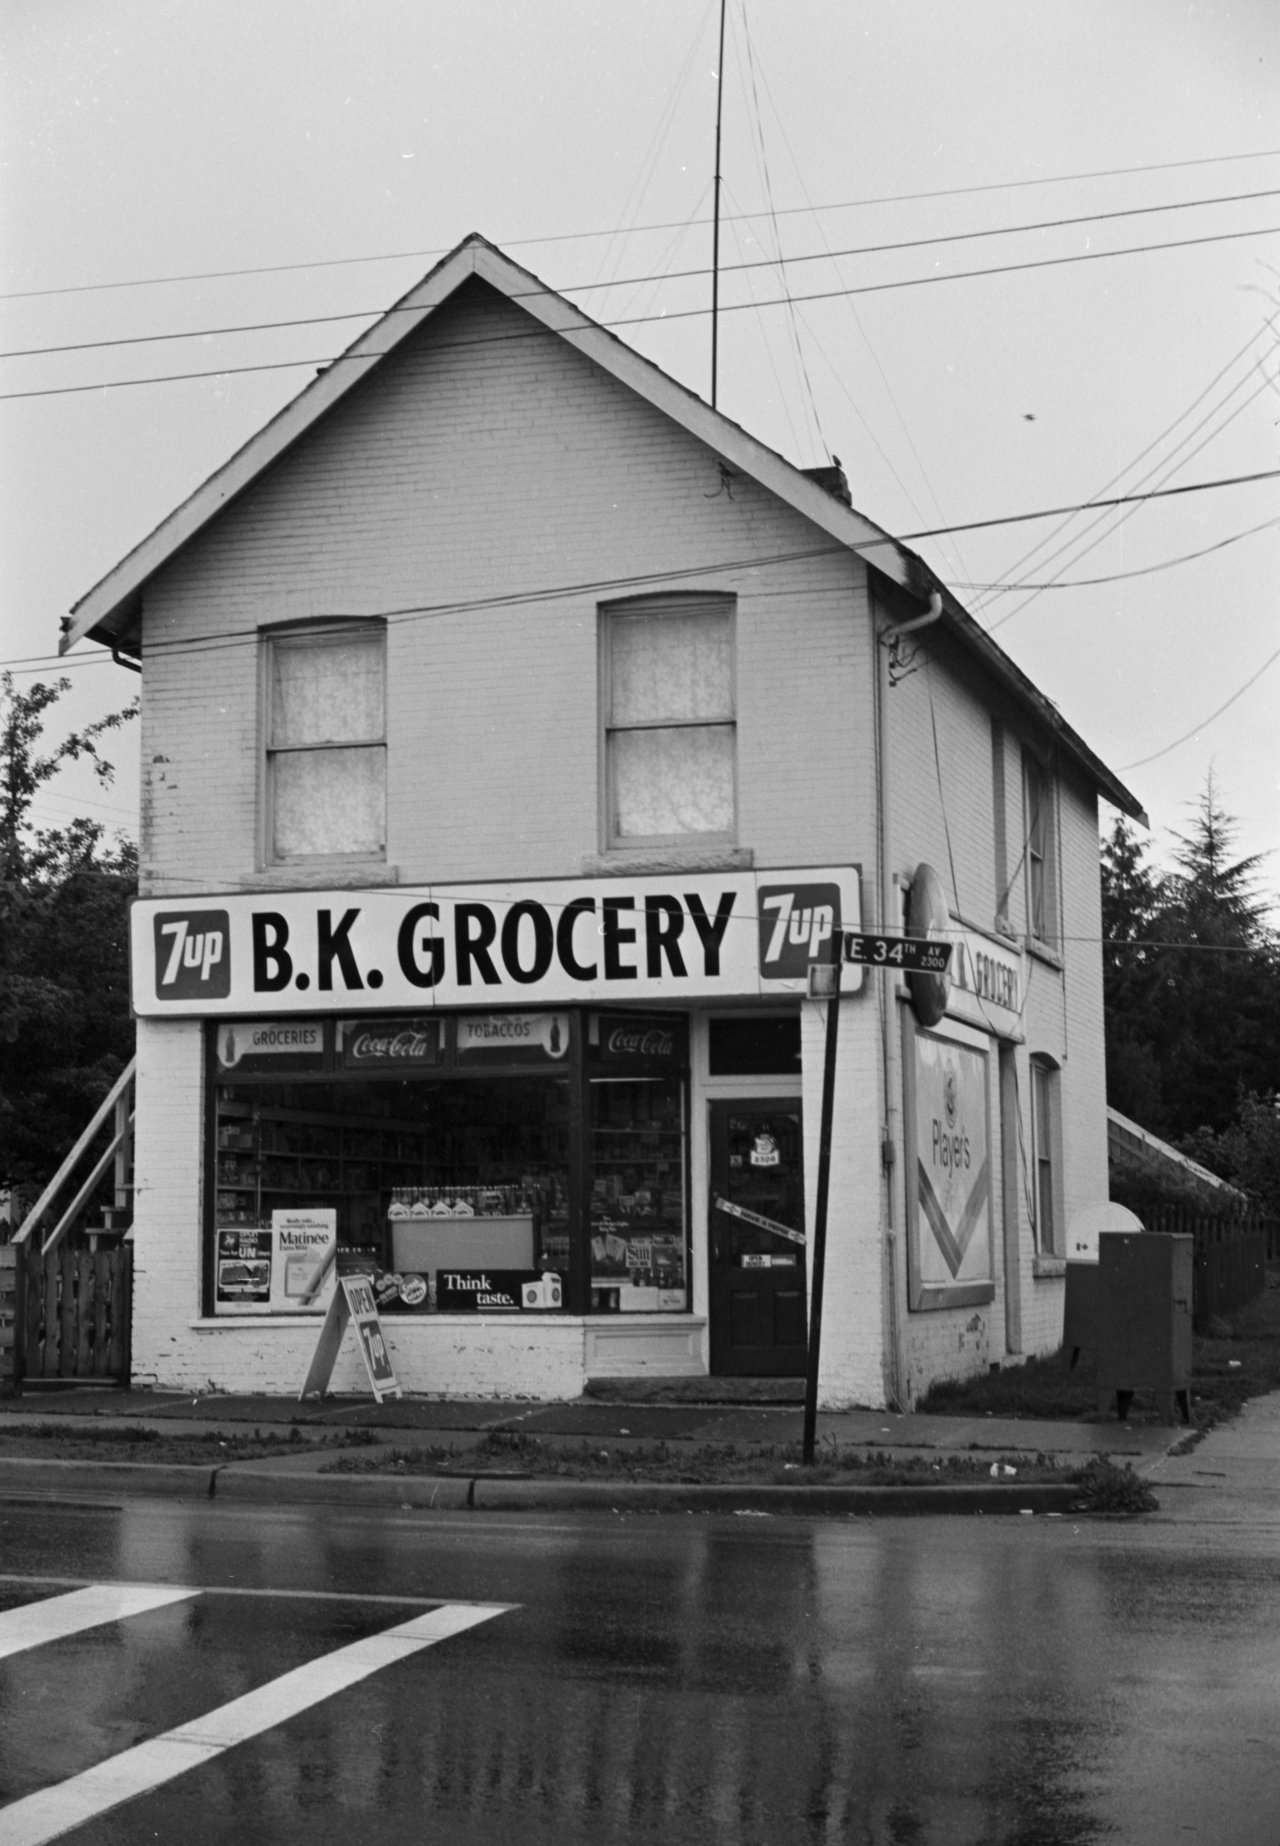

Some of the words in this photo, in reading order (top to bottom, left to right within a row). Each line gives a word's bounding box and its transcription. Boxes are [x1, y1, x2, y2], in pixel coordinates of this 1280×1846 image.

[763, 893, 834, 963] 7up
[161, 920, 224, 986] 7up
[252, 908, 384, 993] B.K.
[397, 892, 738, 989] GROCERY
[850, 938, 868, 960] E.
[928, 946, 942, 957] AV
[921, 956, 946, 968] 2300
[976, 951, 1019, 1012] GROCERY
[253, 1029, 317, 1047] GROCERIES
[467, 1022, 531, 1039] TOBACCOS
[932, 1118, 971, 1179] Player's
[443, 1274, 493, 1291] Think
[348, 1286, 376, 1315] OPEN
[476, 1292, 515, 1305] taste.
